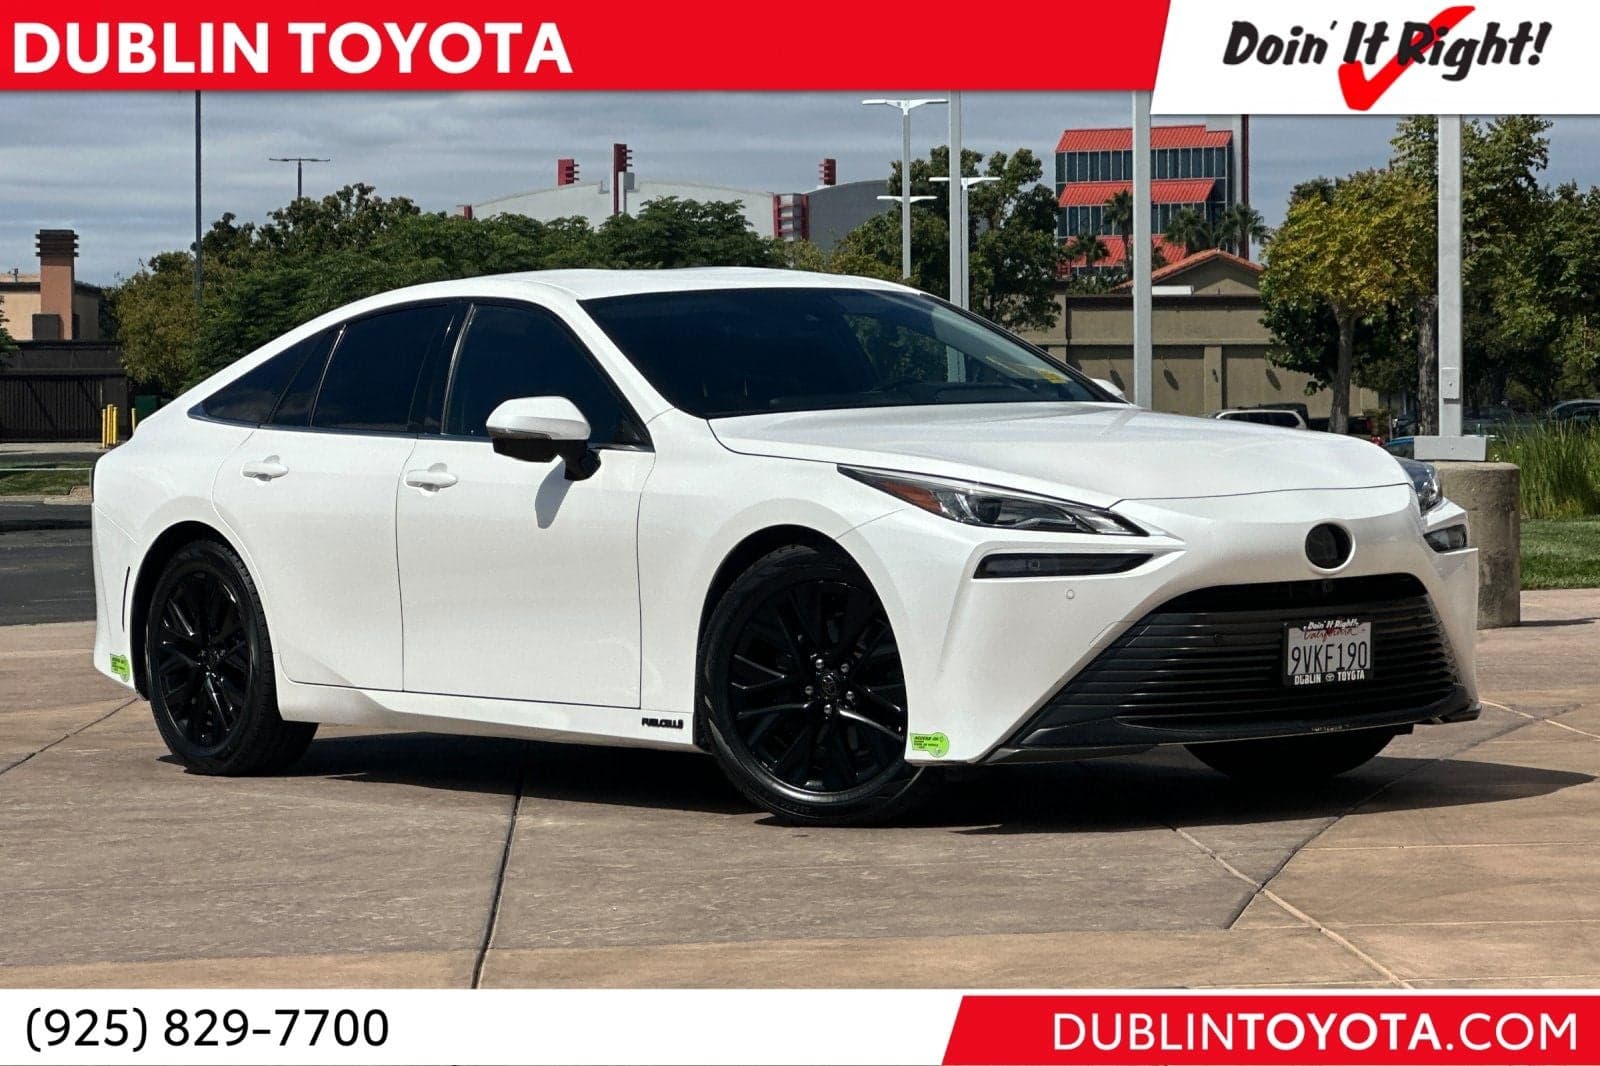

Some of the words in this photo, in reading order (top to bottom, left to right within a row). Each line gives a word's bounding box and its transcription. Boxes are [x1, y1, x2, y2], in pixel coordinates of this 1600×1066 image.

[1291, 641, 1368, 675] 9VKF190
[1294, 673, 1322, 686] DUBLIN
[1337, 670, 1365, 682] TOYOTA
